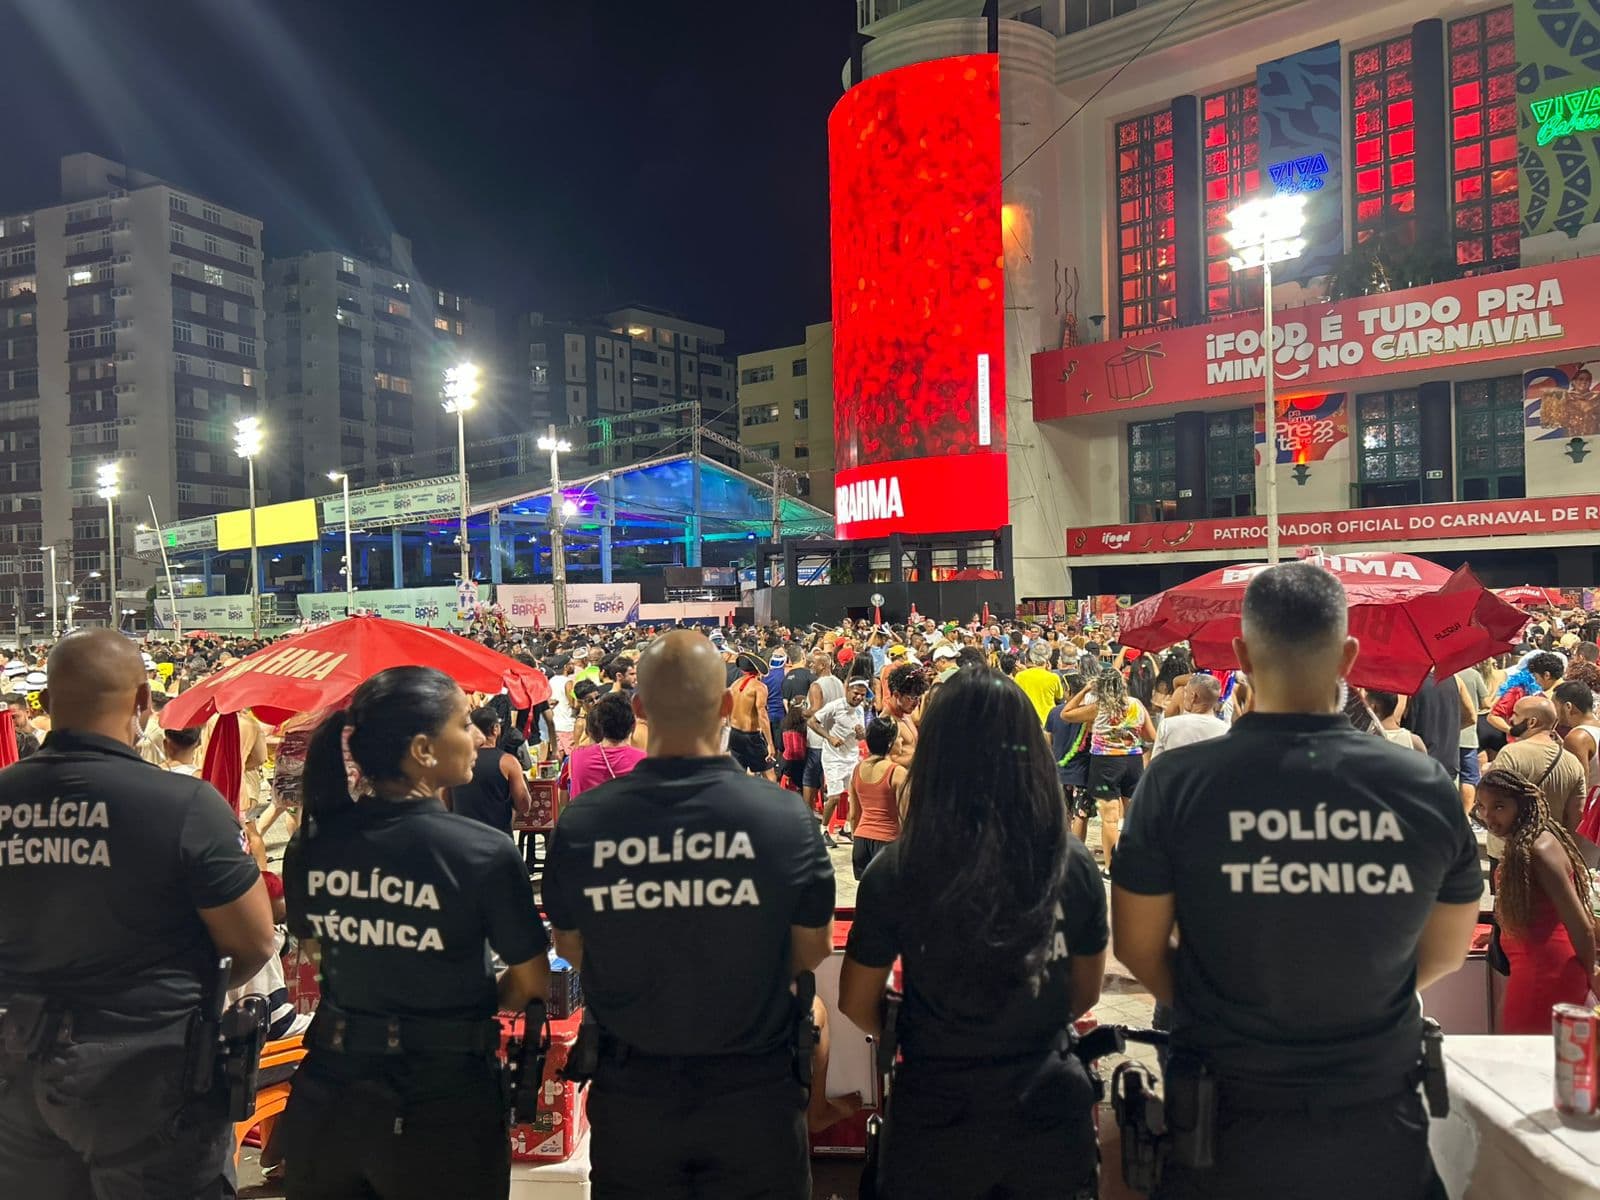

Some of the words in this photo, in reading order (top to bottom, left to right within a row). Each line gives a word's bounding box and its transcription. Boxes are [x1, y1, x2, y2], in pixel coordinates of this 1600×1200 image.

[1320, 309, 1343, 342] É
[1358, 295, 1461, 335] TUDO
[1477, 278, 1564, 318] PRA
[1318, 341, 1364, 369] NO
[1372, 310, 1565, 362] CARNAVAL
[1213, 521, 1333, 540] PATROCNADOR
[1336, 518, 1404, 534] OFICIAL
[1409, 515, 1435, 530] DO
[1440, 509, 1546, 528] CARNAVAL
[1551, 507, 1579, 521] DE
[1229, 803, 1404, 842] POLÍCIA
[592, 828, 756, 868] POLÍCIA
[307, 867, 440, 911] POLÍCIA
[583, 877, 760, 912] TÉCNICA
[1221, 856, 1415, 894] TÉCNICA
[306, 909, 444, 952] TÉCNICA
